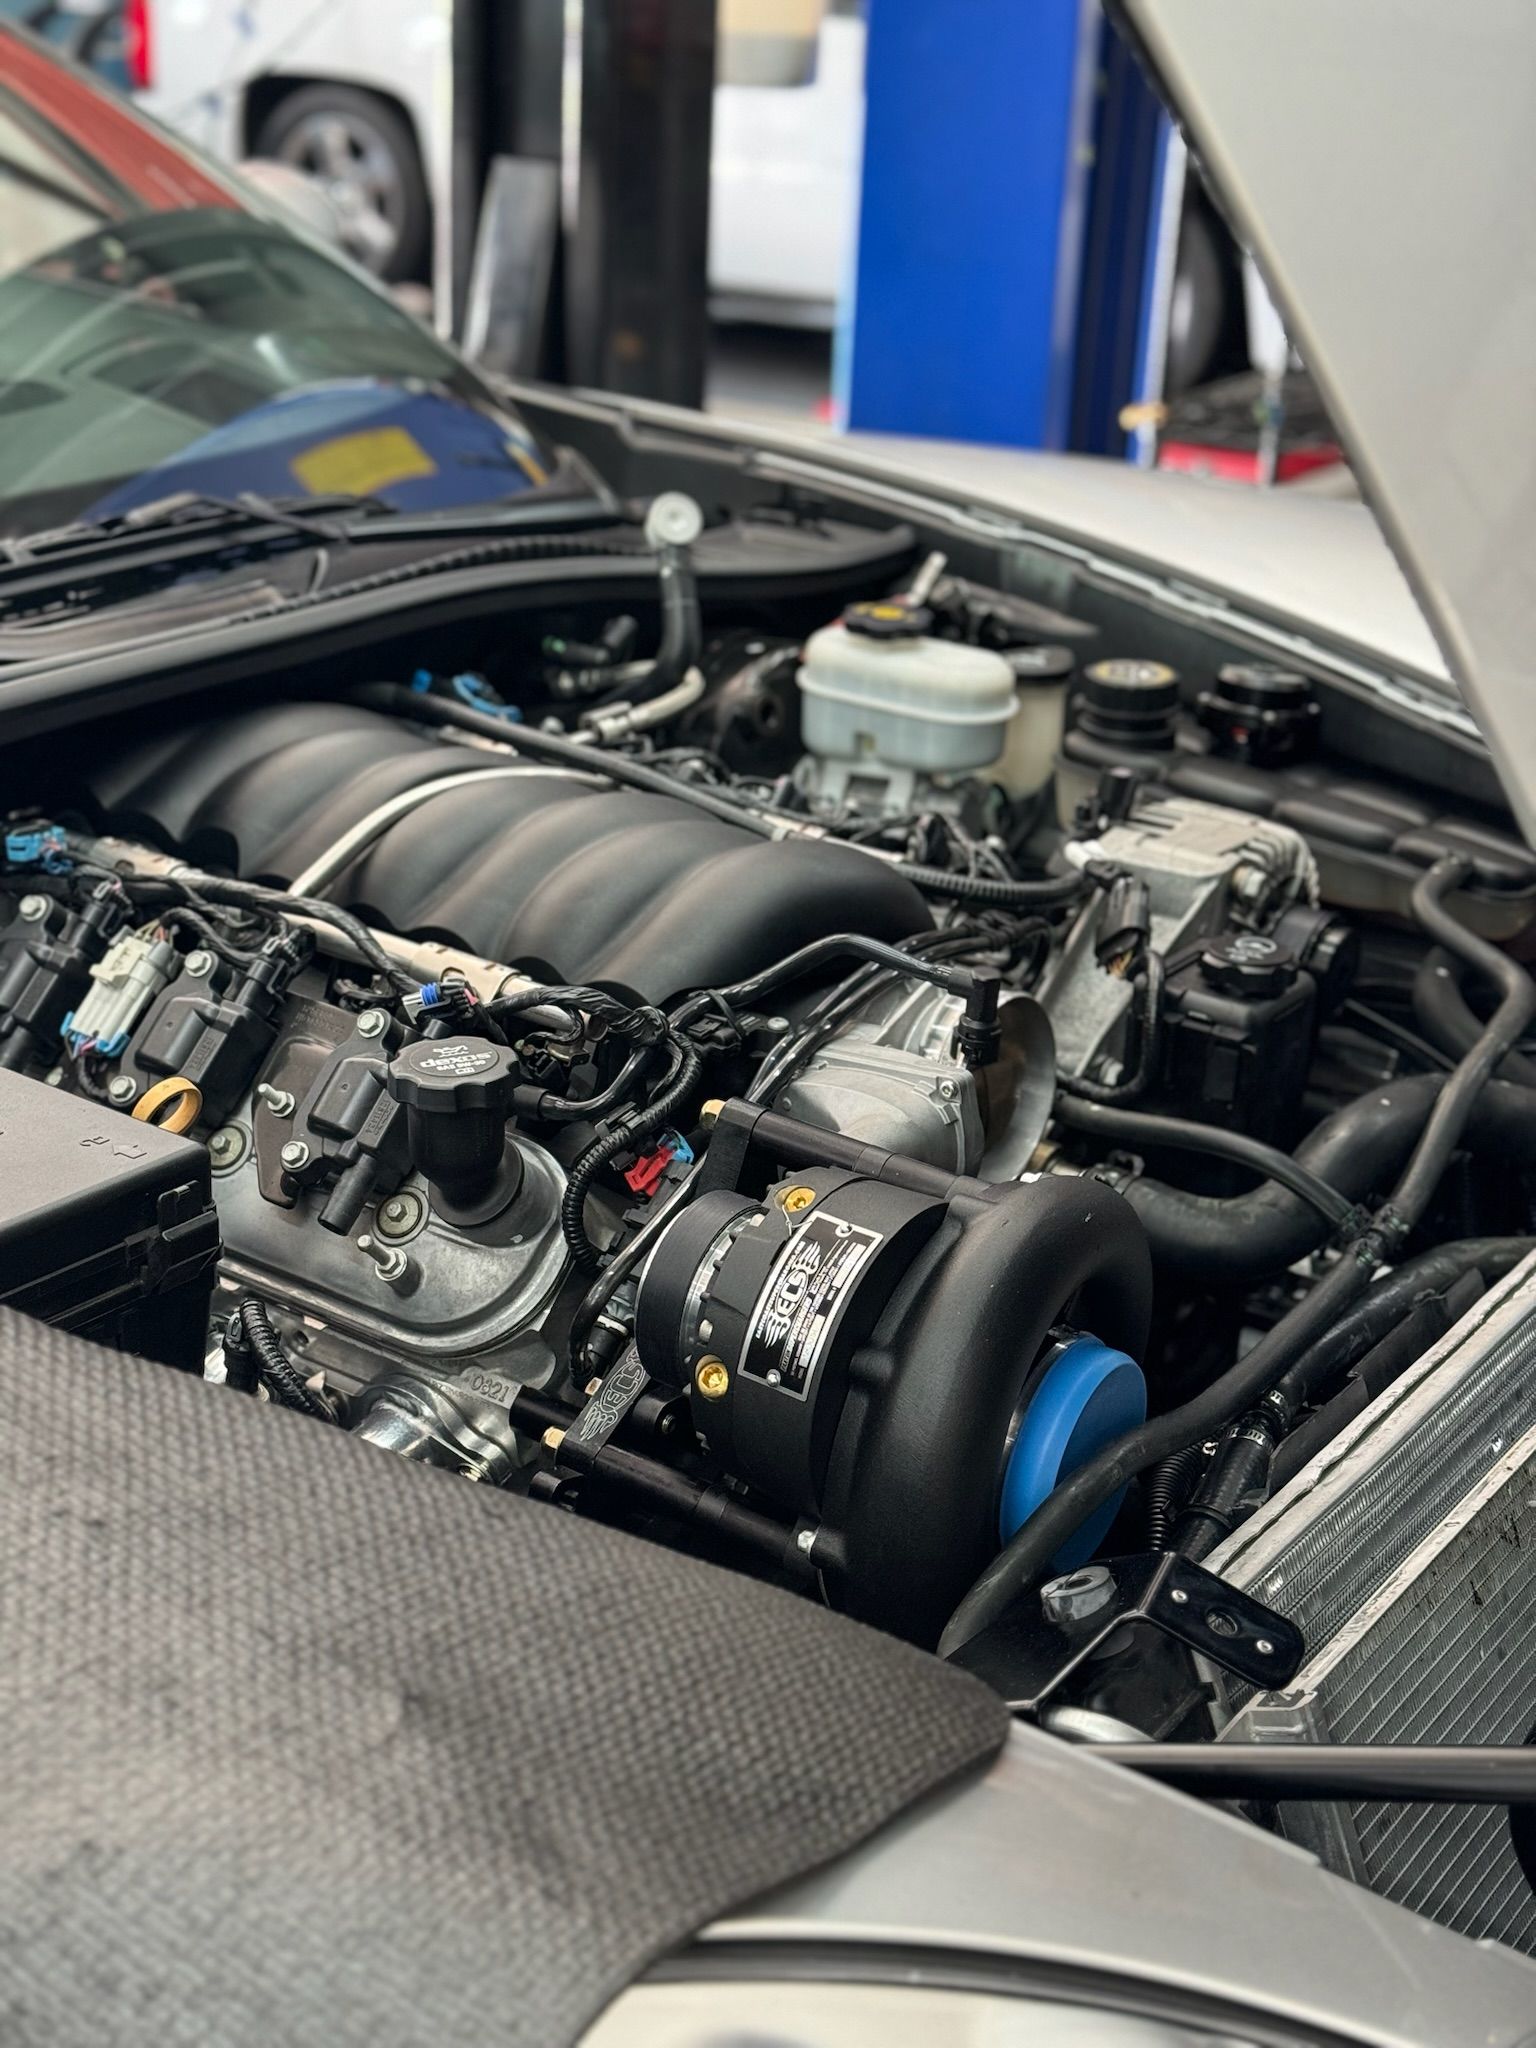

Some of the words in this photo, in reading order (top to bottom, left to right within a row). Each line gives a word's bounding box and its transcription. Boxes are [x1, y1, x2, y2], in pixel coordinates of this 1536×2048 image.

[420, 1052, 491, 1068] dexos
[776, 1269, 806, 1318] ECS
[602, 1361, 644, 1410] ECS
